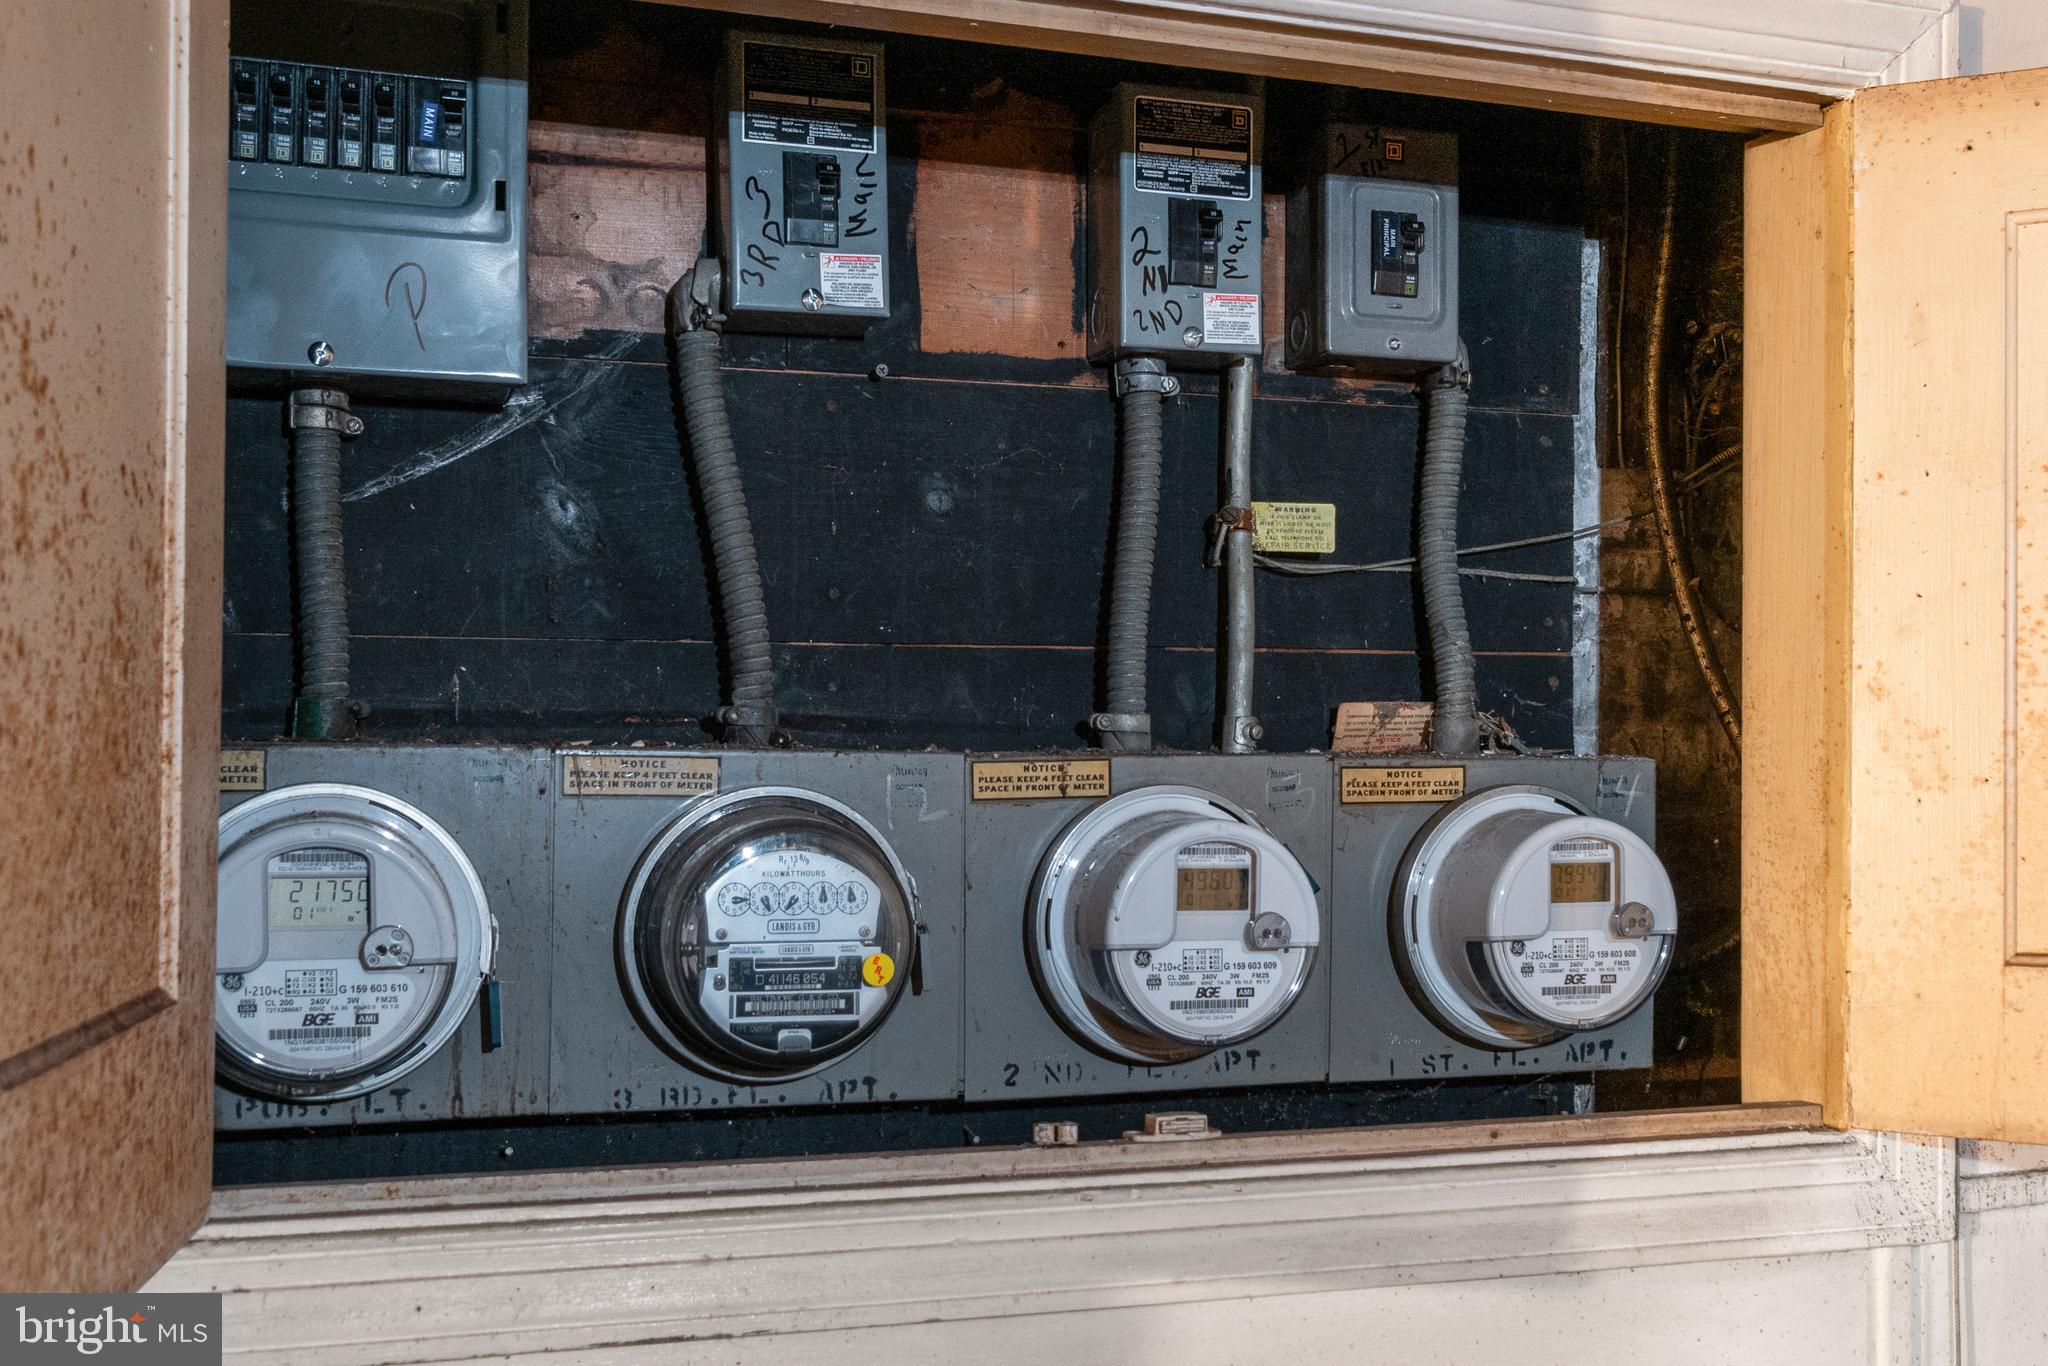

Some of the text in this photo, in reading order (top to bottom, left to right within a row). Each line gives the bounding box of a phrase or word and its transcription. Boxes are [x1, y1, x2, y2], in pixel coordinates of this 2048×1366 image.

[423, 107, 436, 138] MAIN
[1131, 226, 1161, 266] 2
[385, 262, 426, 352] P
[1133, 300, 1183, 334] 2ND
[1024, 764, 1066, 772] NOTICE
[570, 770, 610, 778] PLEASE
[680, 772, 713, 780] CLEAR
[1076, 774, 1105, 782] CLEAR
[570, 780, 604, 788] SPACE
[608, 780, 620, 788] IN
[623, 780, 657, 788] FRONT
[677, 782, 713, 790] METER
[978, 785, 1009, 793] SPACE
[1026, 784, 1055, 792] FRONT
[294, 906, 314, 920] 01
[772, 922, 796, 931] LANDIS
[802, 921, 816, 930] GYR
[1525, 951, 1552, 959] I-210+c
[872, 956, 885, 984] ERT
[1152, 962, 1182, 971] I-210+c
[1224, 962, 1230, 970] G
[1233, 962, 1246, 970] 159
[1248, 962, 1262, 970] 603
[803, 973, 826, 983] 054
[1564, 974, 1587, 985] BGE
[244, 986, 284, 996] I-210+c
[339, 983, 408, 994] G 159 603 610
[1196, 986, 1222, 998] BGE
[1238, 988, 1253, 996] AMI
[302, 1013, 336, 1026] BGE
[358, 1014, 377, 1023] AMI
[1390, 1058, 1394, 1076] 1
[1422, 1054, 1468, 1074] ST.
[1566, 1039, 1628, 1064] APT.
[1003, 1063, 1020, 1087] 2
[1044, 1062, 1098, 1084] ND.
[1206, 1050, 1277, 1075] APT.
[818, 1075, 898, 1102] APT.
